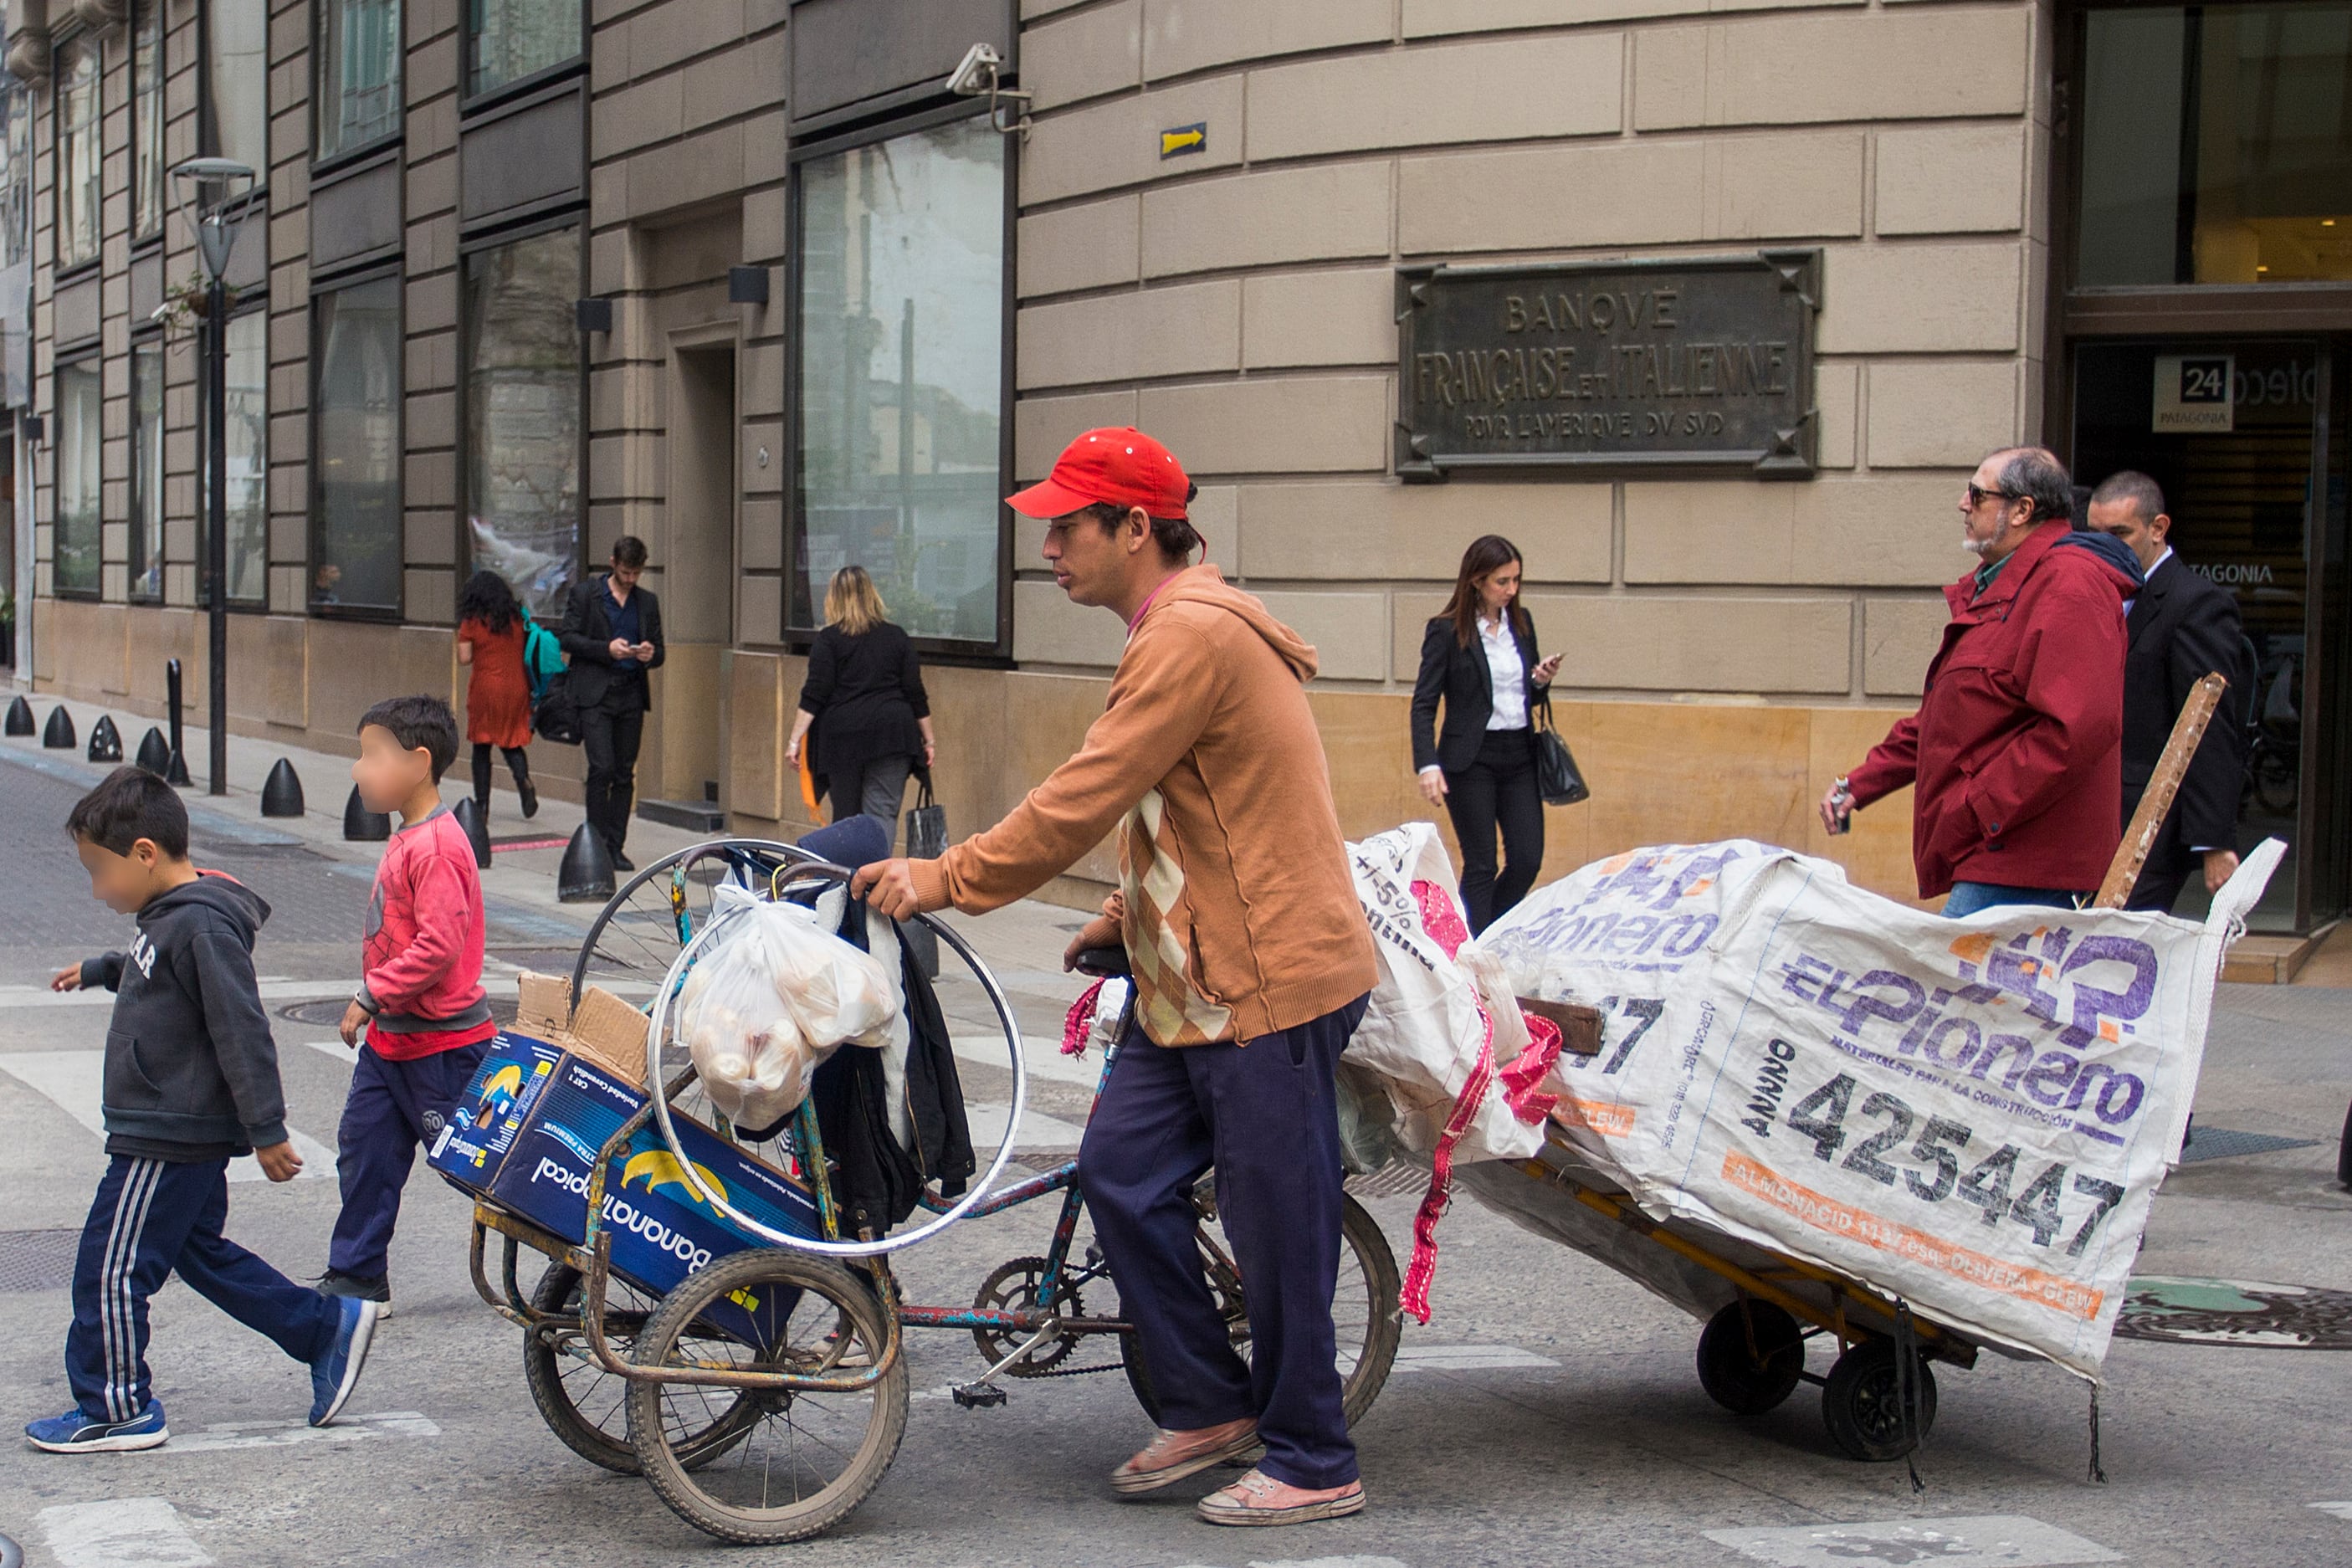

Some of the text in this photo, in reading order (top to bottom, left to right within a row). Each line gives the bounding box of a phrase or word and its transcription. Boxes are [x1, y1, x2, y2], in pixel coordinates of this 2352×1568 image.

[1417, 346, 1575, 408] FRANÇAISE
[1611, 341, 1787, 397] ITALIENNE
[2184, 367, 2223, 397] 24
[2160, 412, 2226, 424] PATAGONIA
[2188, 564, 2273, 583] TAGONIA
[1840, 969, 2144, 1125] Pionero
[572, 1064, 639, 1109] Variedad Cavendish
[573, 1077, 589, 1090] CAT
[543, 1121, 597, 1163] XTRA PREMIUM
[1786, 1073, 2126, 1256] 425447
[1733, 1164, 1853, 1230] ALMONACID
